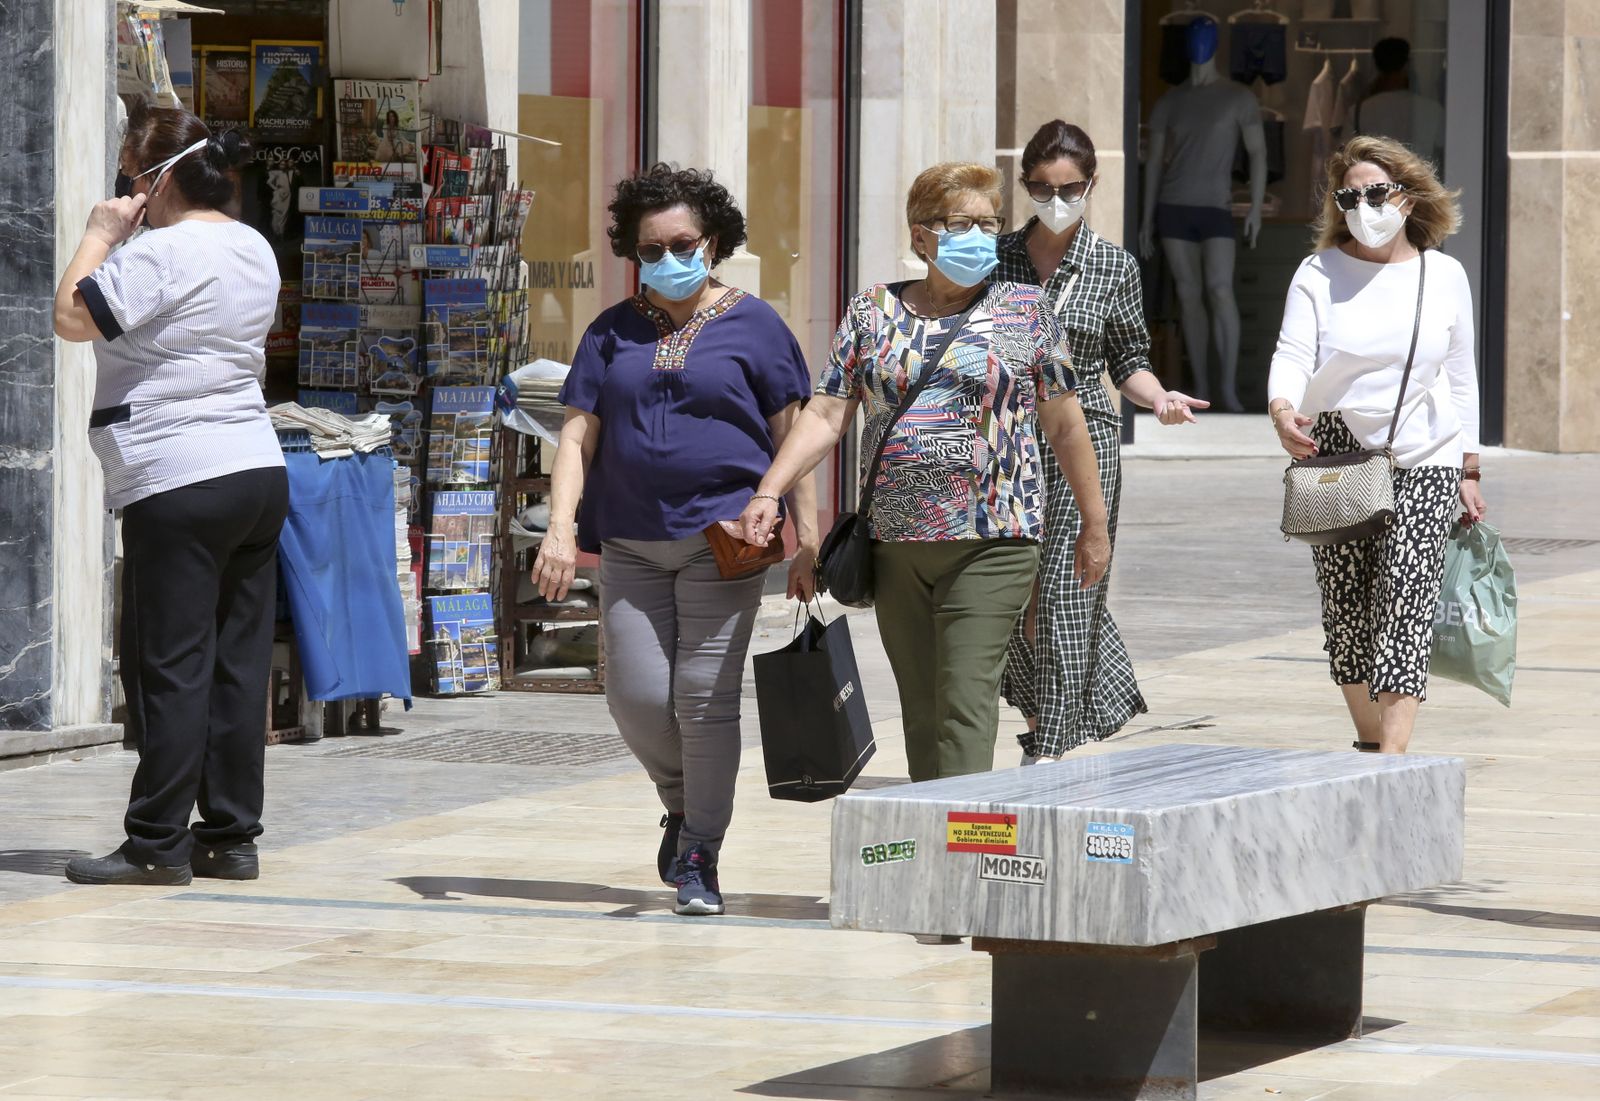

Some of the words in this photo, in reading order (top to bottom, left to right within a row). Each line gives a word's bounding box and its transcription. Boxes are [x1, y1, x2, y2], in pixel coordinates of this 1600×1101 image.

[216, 60, 247, 68] HISTORIA
[262, 52, 312, 66] HISTORIA
[309, 218, 357, 235] MÁLAGA
[528, 261, 556, 289] IMBA
[558, 261, 566, 289] Y
[568, 261, 595, 289] LOLA
[437, 391, 491, 404] МАЛАГА
[436, 493, 494, 507] АНДАЛУСИЯ
[436, 597, 489, 613] MÁLAGA
[983, 857, 1045, 880] MORSA
